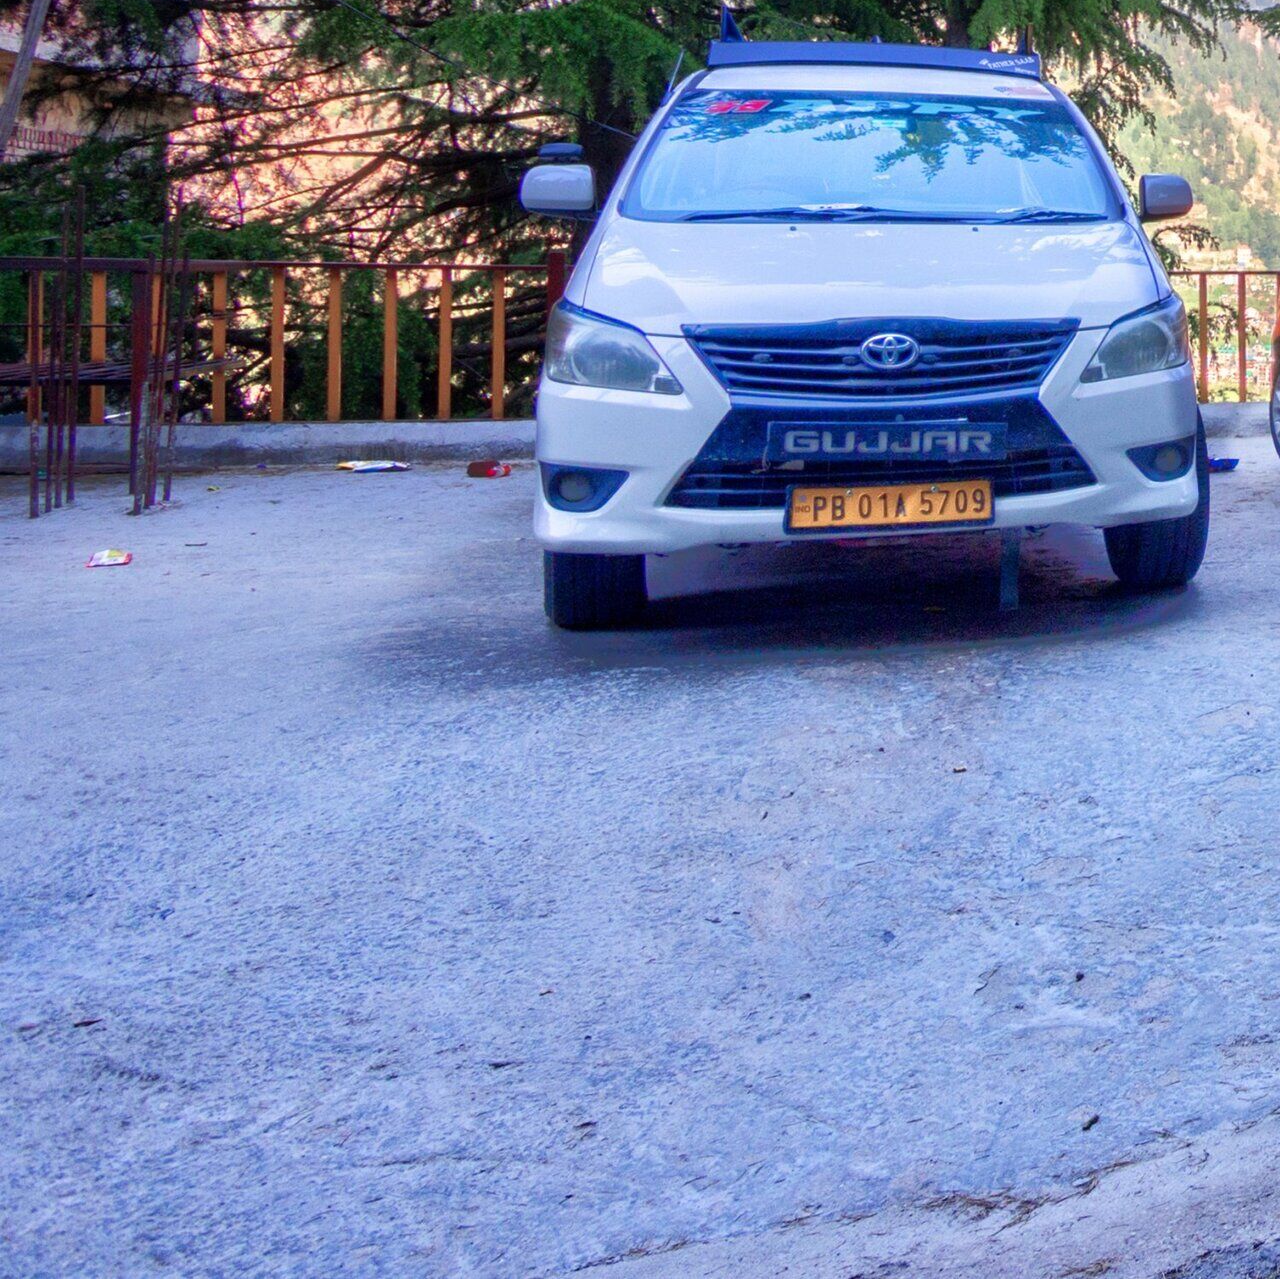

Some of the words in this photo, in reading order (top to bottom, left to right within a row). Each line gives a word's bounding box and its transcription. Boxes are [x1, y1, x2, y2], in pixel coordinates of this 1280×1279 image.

[784, 430, 993, 454] GUJJAR
[813, 494, 846, 522] PB
[920, 488, 985, 516] 5709
